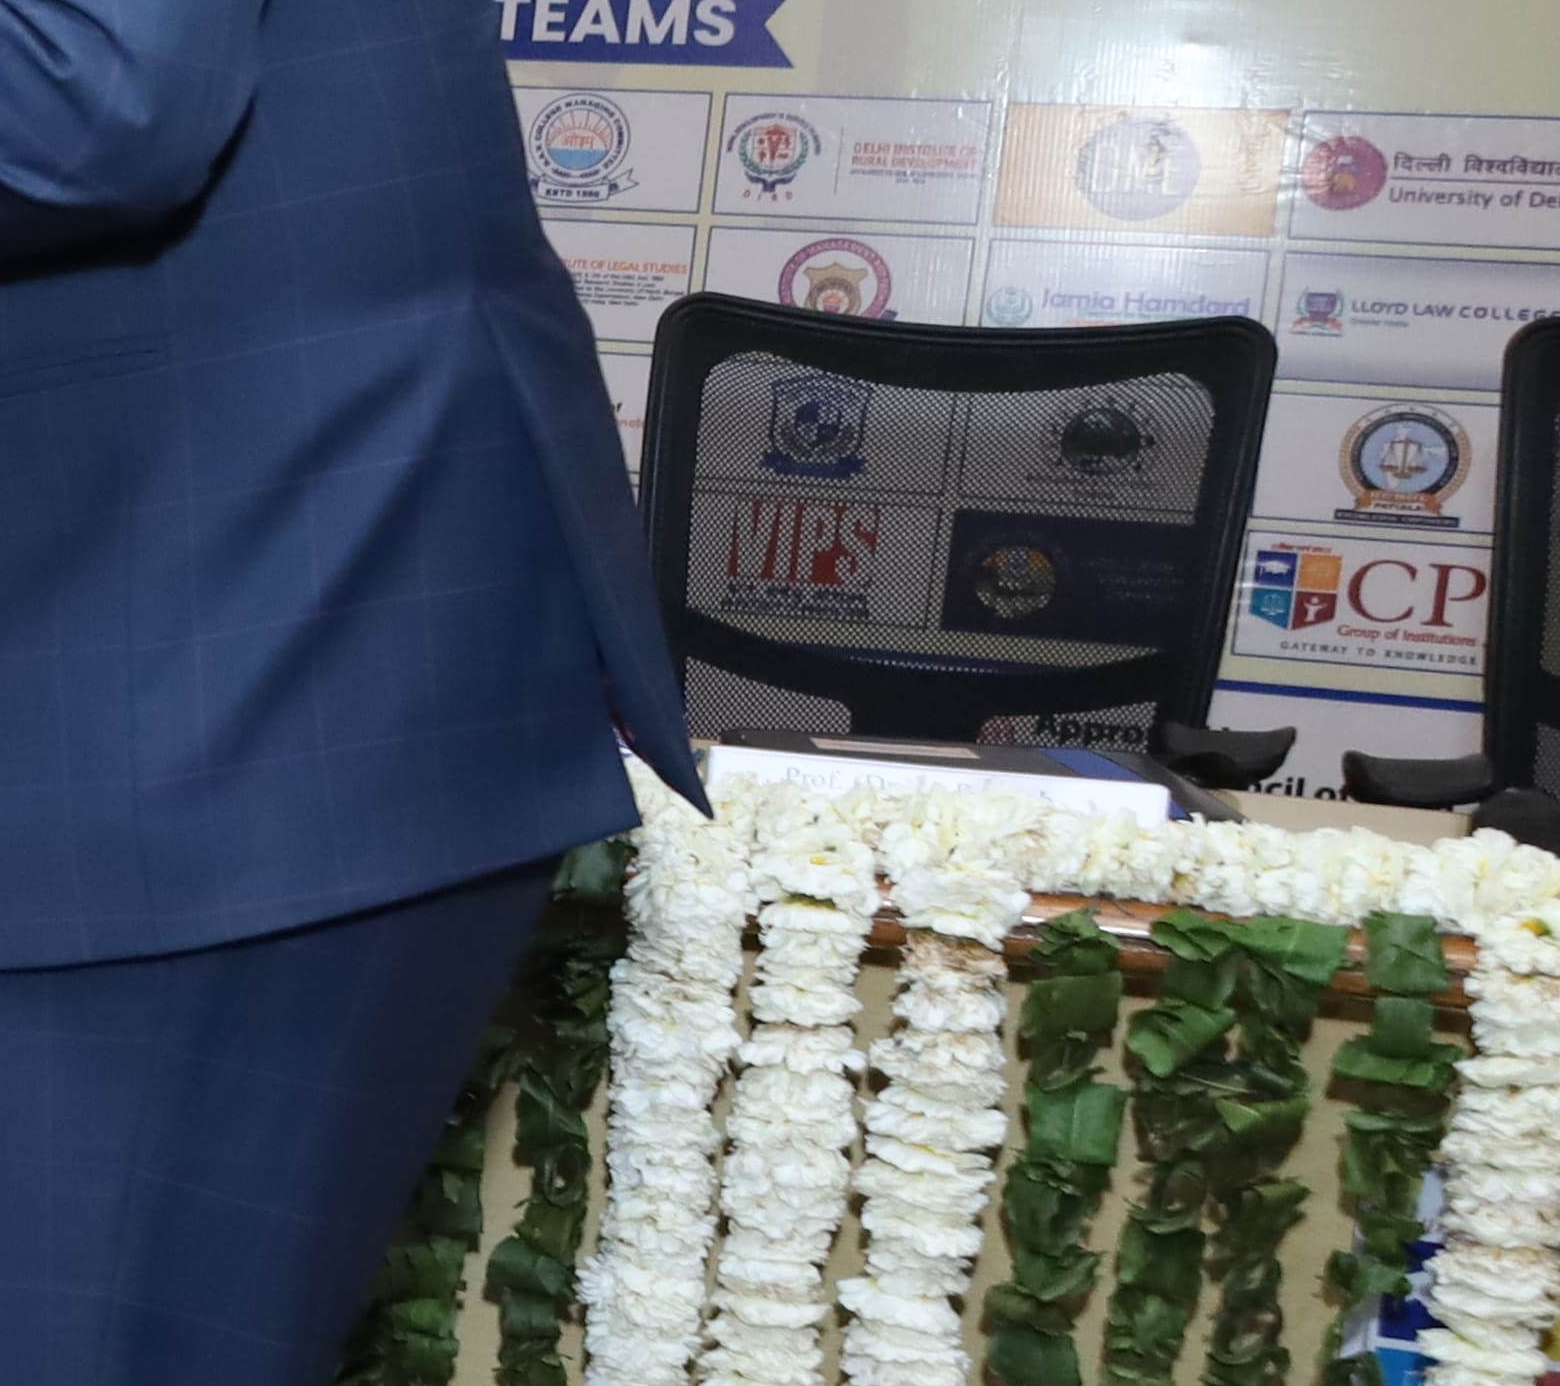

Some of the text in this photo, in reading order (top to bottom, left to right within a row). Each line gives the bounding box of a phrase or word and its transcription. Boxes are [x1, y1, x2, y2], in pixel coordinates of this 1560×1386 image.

[854, 142, 890, 154] DELHI
[894, 143, 956, 156] INSTITUTE
[851, 155, 977, 169] RURAL DEVELOPMENT
[1393, 151, 1451, 173] दिल्ली
[1388, 187, 1493, 209] University
[1500, 190, 1524, 208] of
[608, 261, 640, 272] LEGAL
[643, 262, 688, 274] STUDIES
[1041, 289, 1250, 316] Jamia Hamdard
[1351, 300, 1408, 315] LLOYD
[1412, 303, 1455, 318] LAW
[1347, 559, 1487, 628] CP
[1337, 625, 1477, 647] Group of Institutions
[1280, 641, 1477, 665] GATEWAY TO KNOWLEDGE
